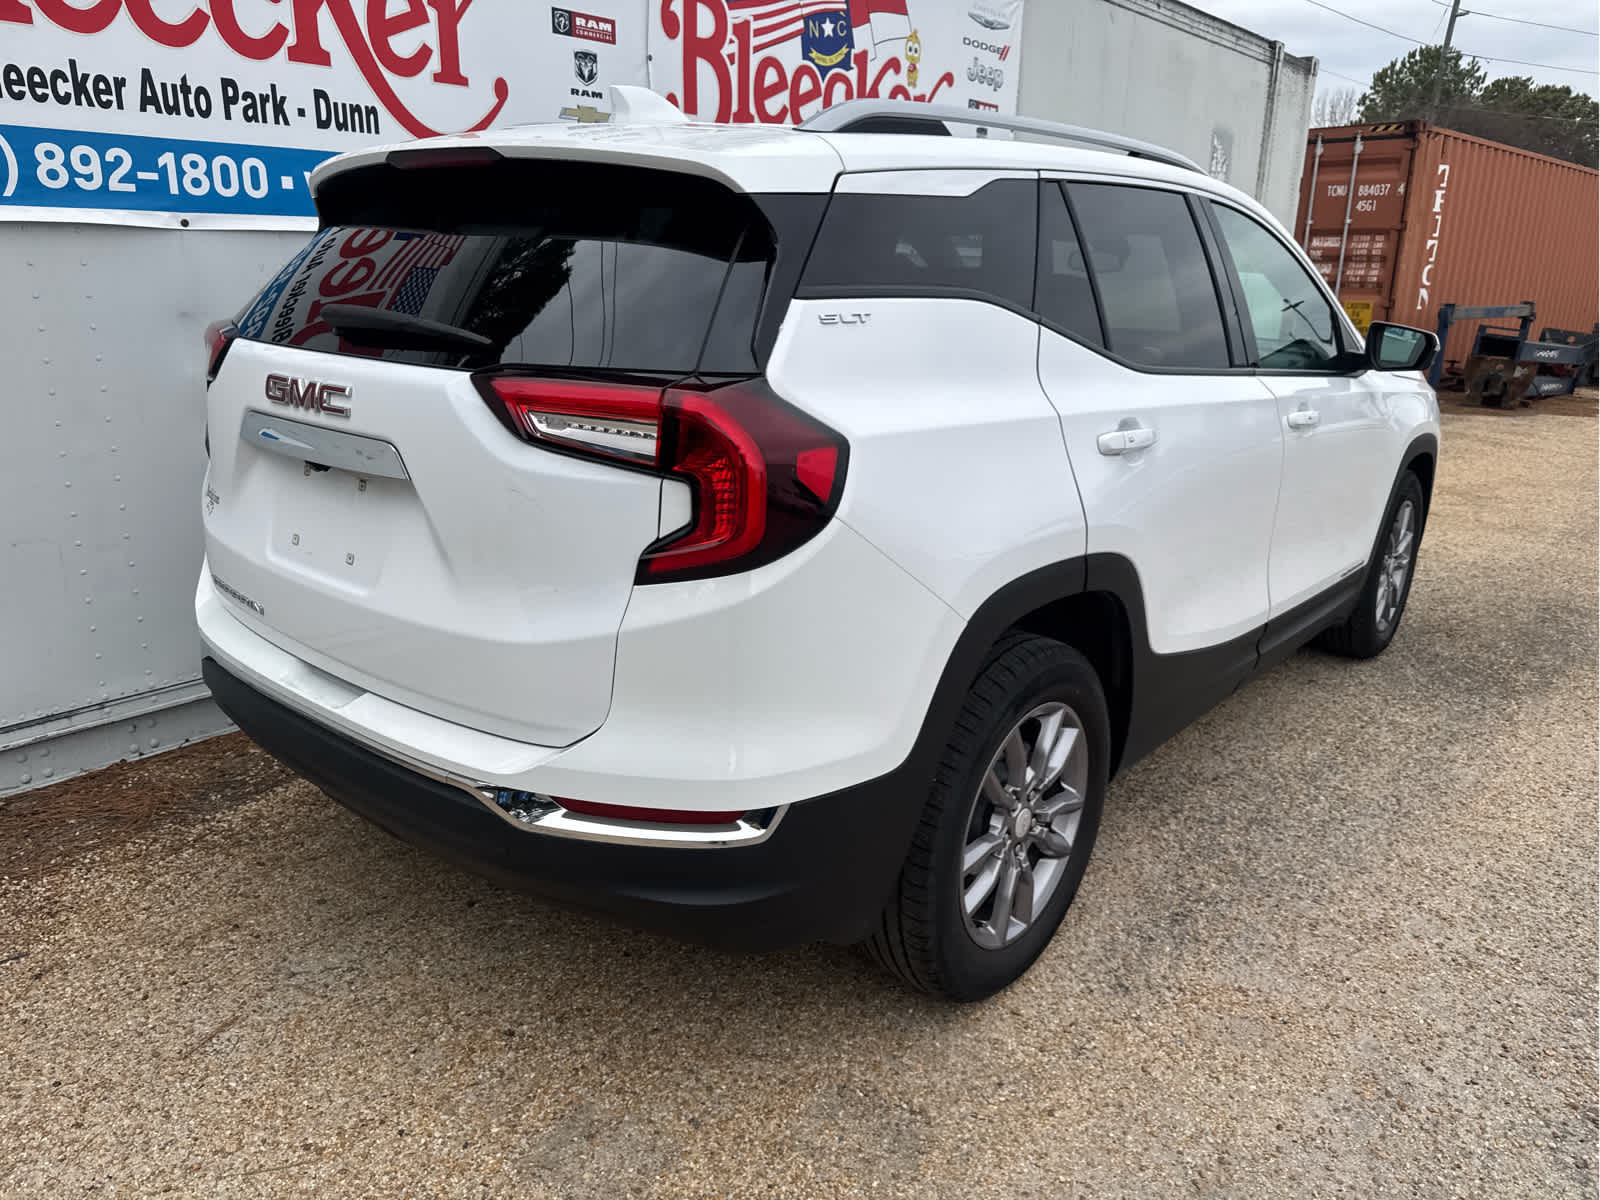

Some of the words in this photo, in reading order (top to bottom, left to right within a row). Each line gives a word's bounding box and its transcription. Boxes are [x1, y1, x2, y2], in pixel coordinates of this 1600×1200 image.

[576, 17, 612, 32] RAM
[809, 20, 819, 38] N
[837, 20, 847, 37] C
[576, 28, 613, 41] COMMERCIAL
[963, 36, 1003, 55] DODGE
[967, 56, 1004, 92] Jeep
[0, 58, 127, 110] eecker
[139, 67, 212, 119] Auto
[220, 77, 290, 126] Park
[313, 88, 380, 135] Dunn
[570, 87, 603, 99] RAM
[33, 142, 269, 199] 892-1800
[1327, 184, 1348, 197] TCNU
[1358, 183, 1391, 197] 884037
[1355, 199, 1377, 212] 45G1
[264, 373, 352, 418] GMC
